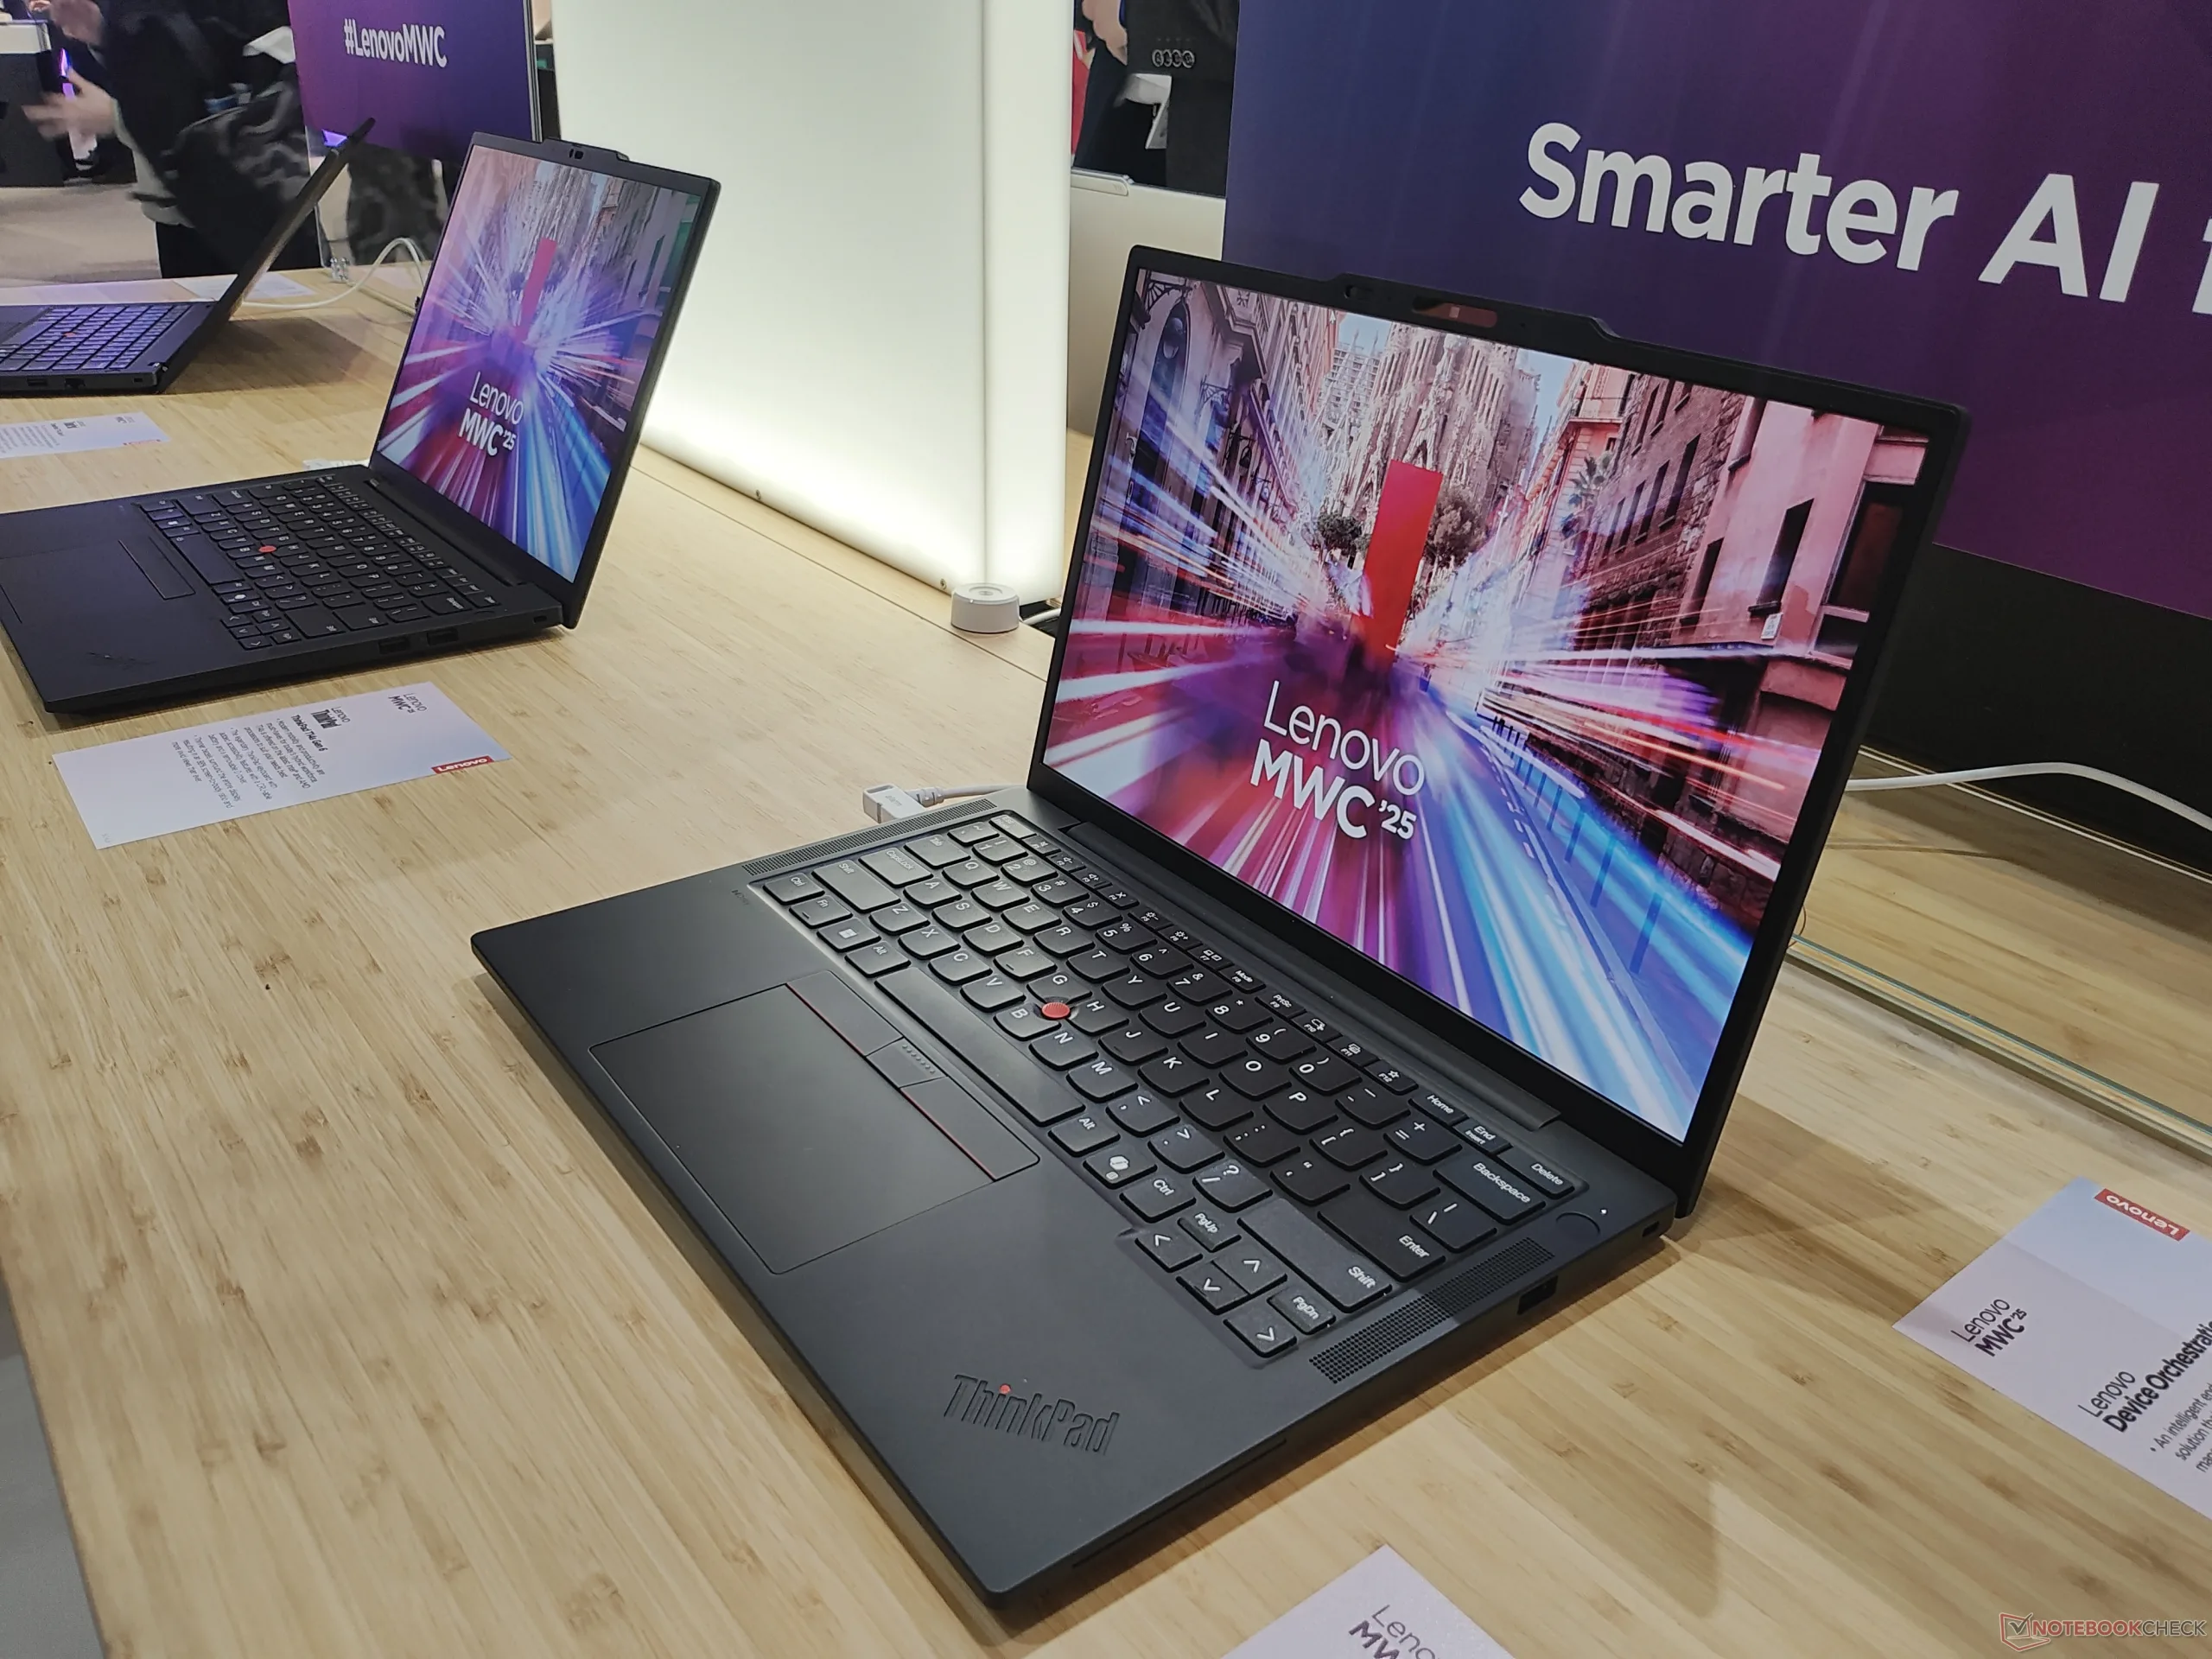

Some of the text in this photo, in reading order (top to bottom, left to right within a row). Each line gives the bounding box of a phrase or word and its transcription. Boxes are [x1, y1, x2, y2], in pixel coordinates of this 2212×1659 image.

[344, 18, 448, 67] #LenovoMWC
[1519, 123, 1959, 271] Smarter
[1978, 174, 2159, 302] AI
[470, 372, 524, 424] Lenovo
[1263, 680, 1425, 796] Lenovo
[437, 759, 487, 772] Lenovo
[929, 838, 943, 847] Tab
[838, 863, 855, 874] Shift
[964, 861, 979, 870] Q
[791, 876, 805, 887] Ctrl
[994, 881, 1012, 891] W
[893, 906, 909, 914] Z
[955, 902, 969, 911] S
[1023, 905, 1039, 913] E
[921, 929, 938, 938] X
[985, 925, 1001, 934] D
[1056, 926, 1072, 936] R
[1103, 929, 1118, 938] 5
[874, 945, 888, 956] Alt
[1017, 948, 1034, 957] F
[1091, 950, 1106, 959] T
[954, 952, 969, 962] C
[1139, 953, 1153, 962] 6
[1052, 975, 1068, 985] G
[1127, 976, 1143, 985] Y
[1235, 970, 1253, 982] Mode
[987, 977, 1002, 988] V
[1086, 1001, 1105, 1012] H
[1164, 1002, 1181, 1013] U
[1214, 1005, 1230, 1014] 8
[1011, 1007, 1028, 1019] B
[1054, 1032, 1074, 1044] N
[1126, 1030, 1141, 1039] J
[1255, 1033, 1270, 1043] 9
[1091, 1061, 1113, 1075] M
[1163, 1057, 1182, 1069] K
[1245, 1060, 1262, 1071] O
[1299, 1064, 1315, 1073] 0
[1205, 1089, 1220, 1101] L
[1289, 1091, 1307, 1102] P
[1427, 1095, 1454, 1114] Home
[1079, 1117, 1095, 1130] Alt
[1473, 1126, 1496, 1141] End
[1223, 1165, 1239, 1175] ?
[1531, 1163, 1563, 1185] Delete
[1154, 1179, 1174, 1196] Ctrl
[1473, 1162, 1531, 1203] Backspace
[2107, 1195, 2179, 1235] Lenovo
[1195, 1213, 1218, 1234] PgUp
[1399, 1235, 1429, 1258] Enter
[1349, 1266, 1377, 1288] Shift
[1293, 1296, 1319, 1319] PgDn
[1950, 1300, 2010, 1342] Lenovo
[2102, 1321, 2212, 1433] Device Orchestrati
[2077, 1371, 2135, 1417] Lenovo
[944, 1374, 1120, 1455] ThinkPad
[2153, 1434, 2173, 1448] An
[2163, 1397, 2208, 1436] intelligent
[2175, 1428, 2210, 1460] solution
[1372, 1605, 1437, 1659] Leno
